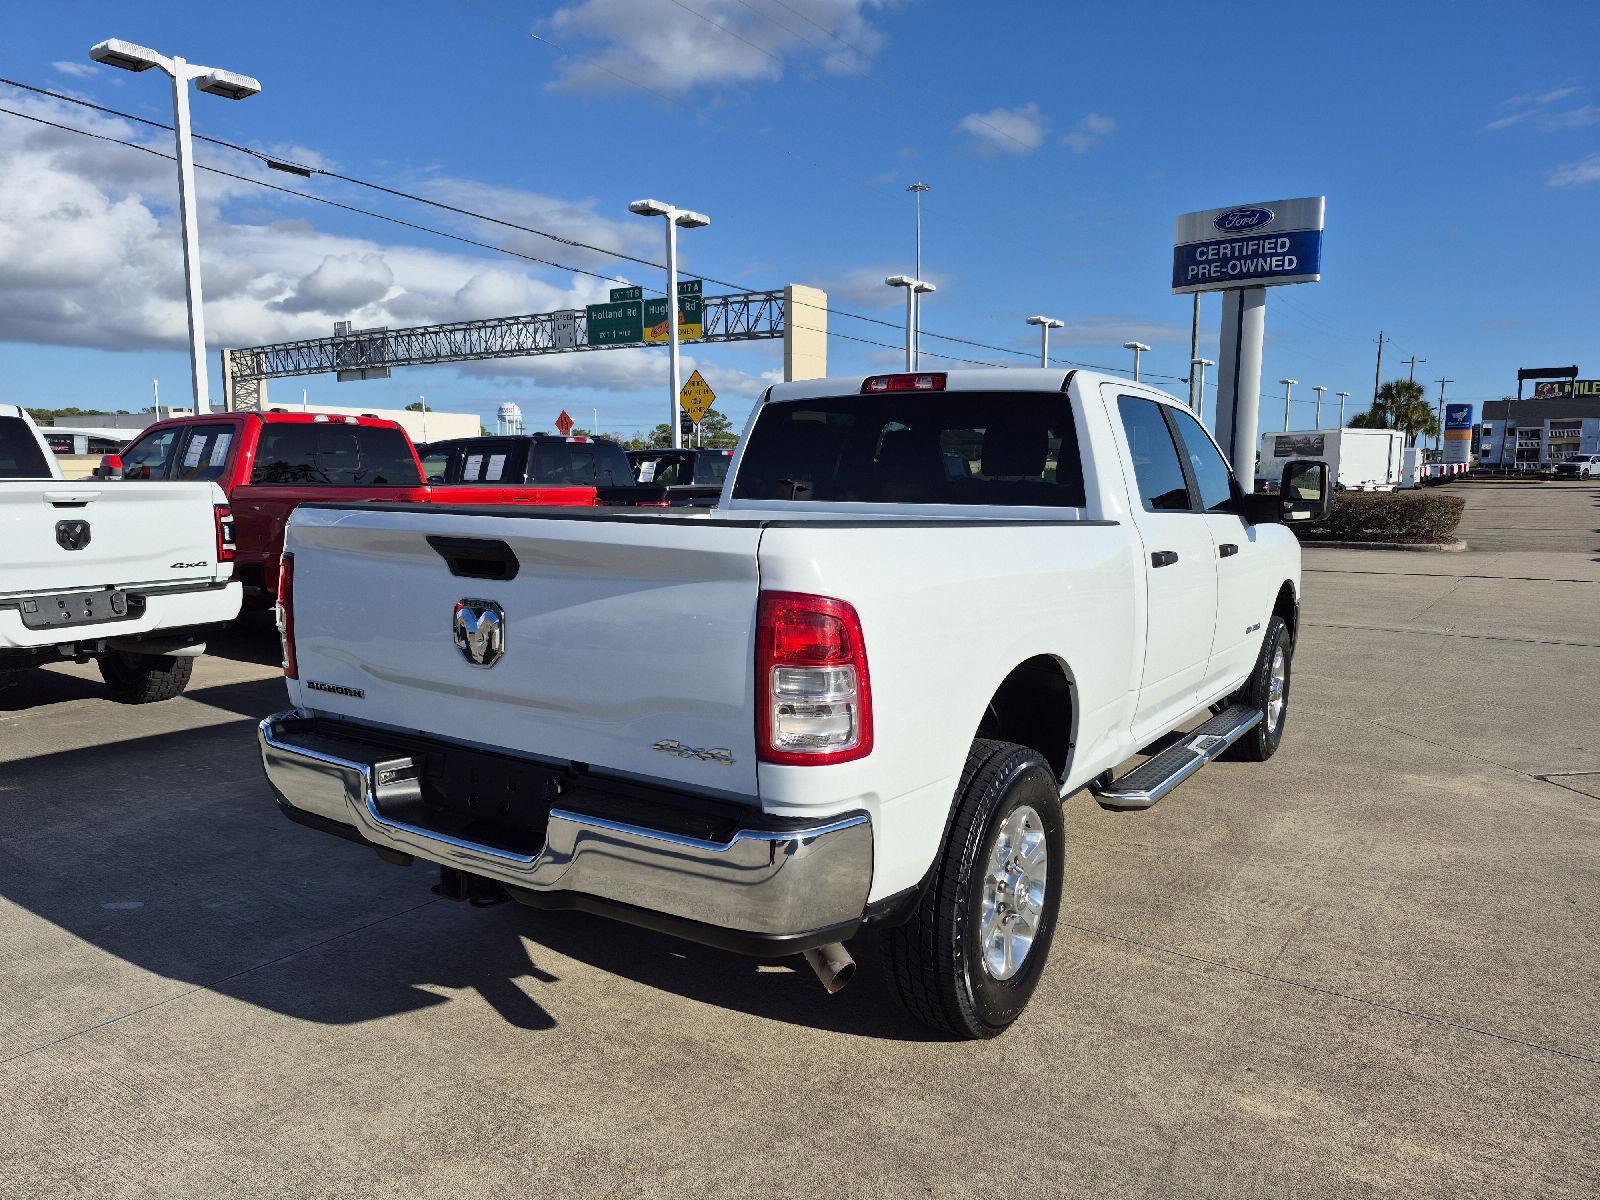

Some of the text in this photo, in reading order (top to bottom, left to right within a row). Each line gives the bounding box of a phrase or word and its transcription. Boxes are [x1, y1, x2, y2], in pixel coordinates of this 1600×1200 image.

[1226, 209, 1260, 228] Ford
[1196, 237, 1291, 261] CERTIFIED
[1187, 255, 1298, 280] PRE-OWNED
[592, 307, 637, 320] Holland Rd
[649, 302, 696, 315] Hugs Rd
[1553, 383, 1559, 393] 1
